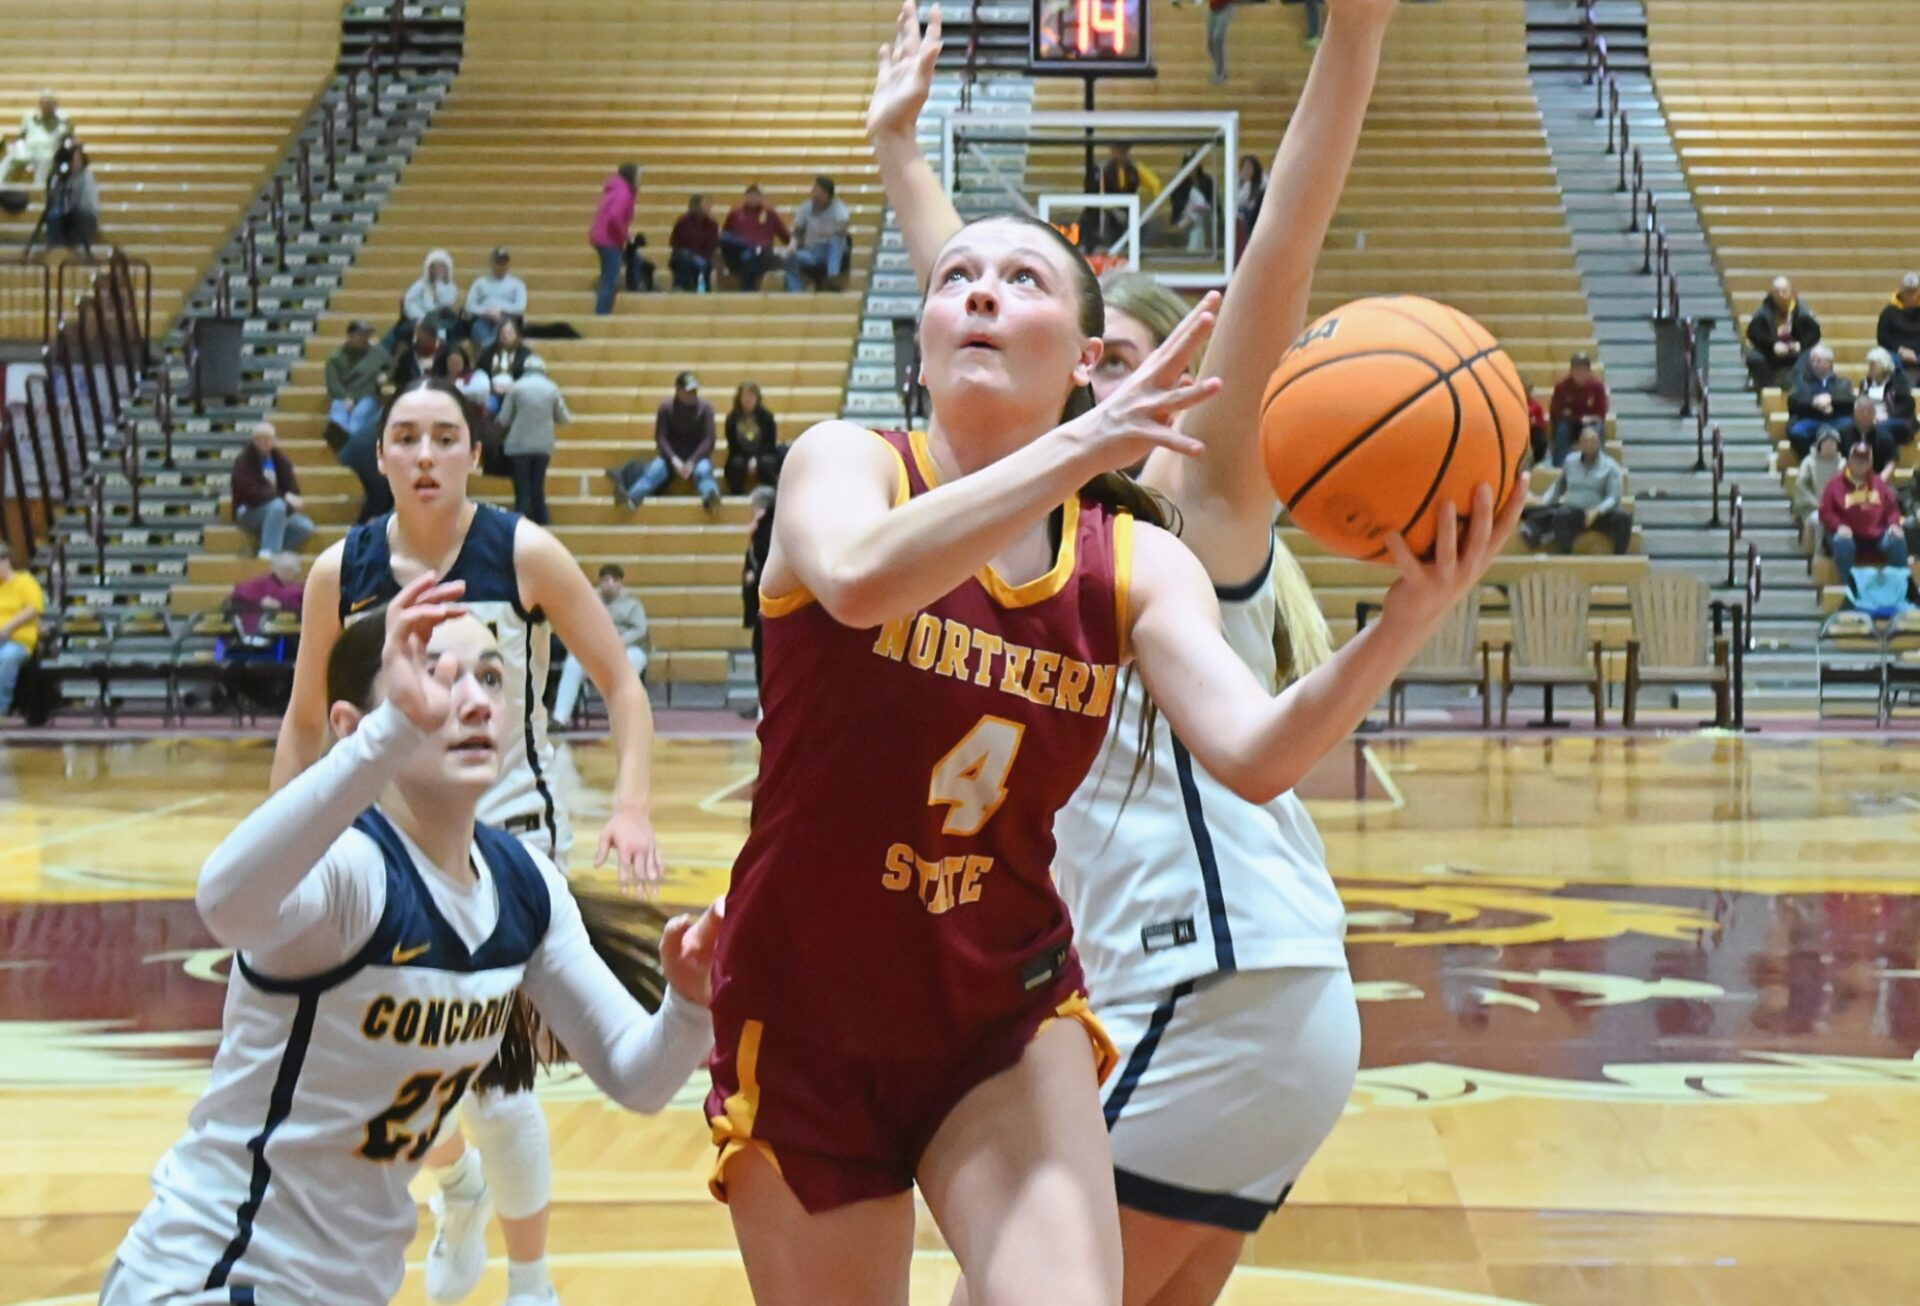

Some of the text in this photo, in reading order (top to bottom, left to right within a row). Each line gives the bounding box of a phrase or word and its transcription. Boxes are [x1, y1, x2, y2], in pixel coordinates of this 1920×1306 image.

[1078, 0, 1125, 55] 14
[872, 611, 1117, 718] NORTHERN
[928, 714, 1026, 837] 4
